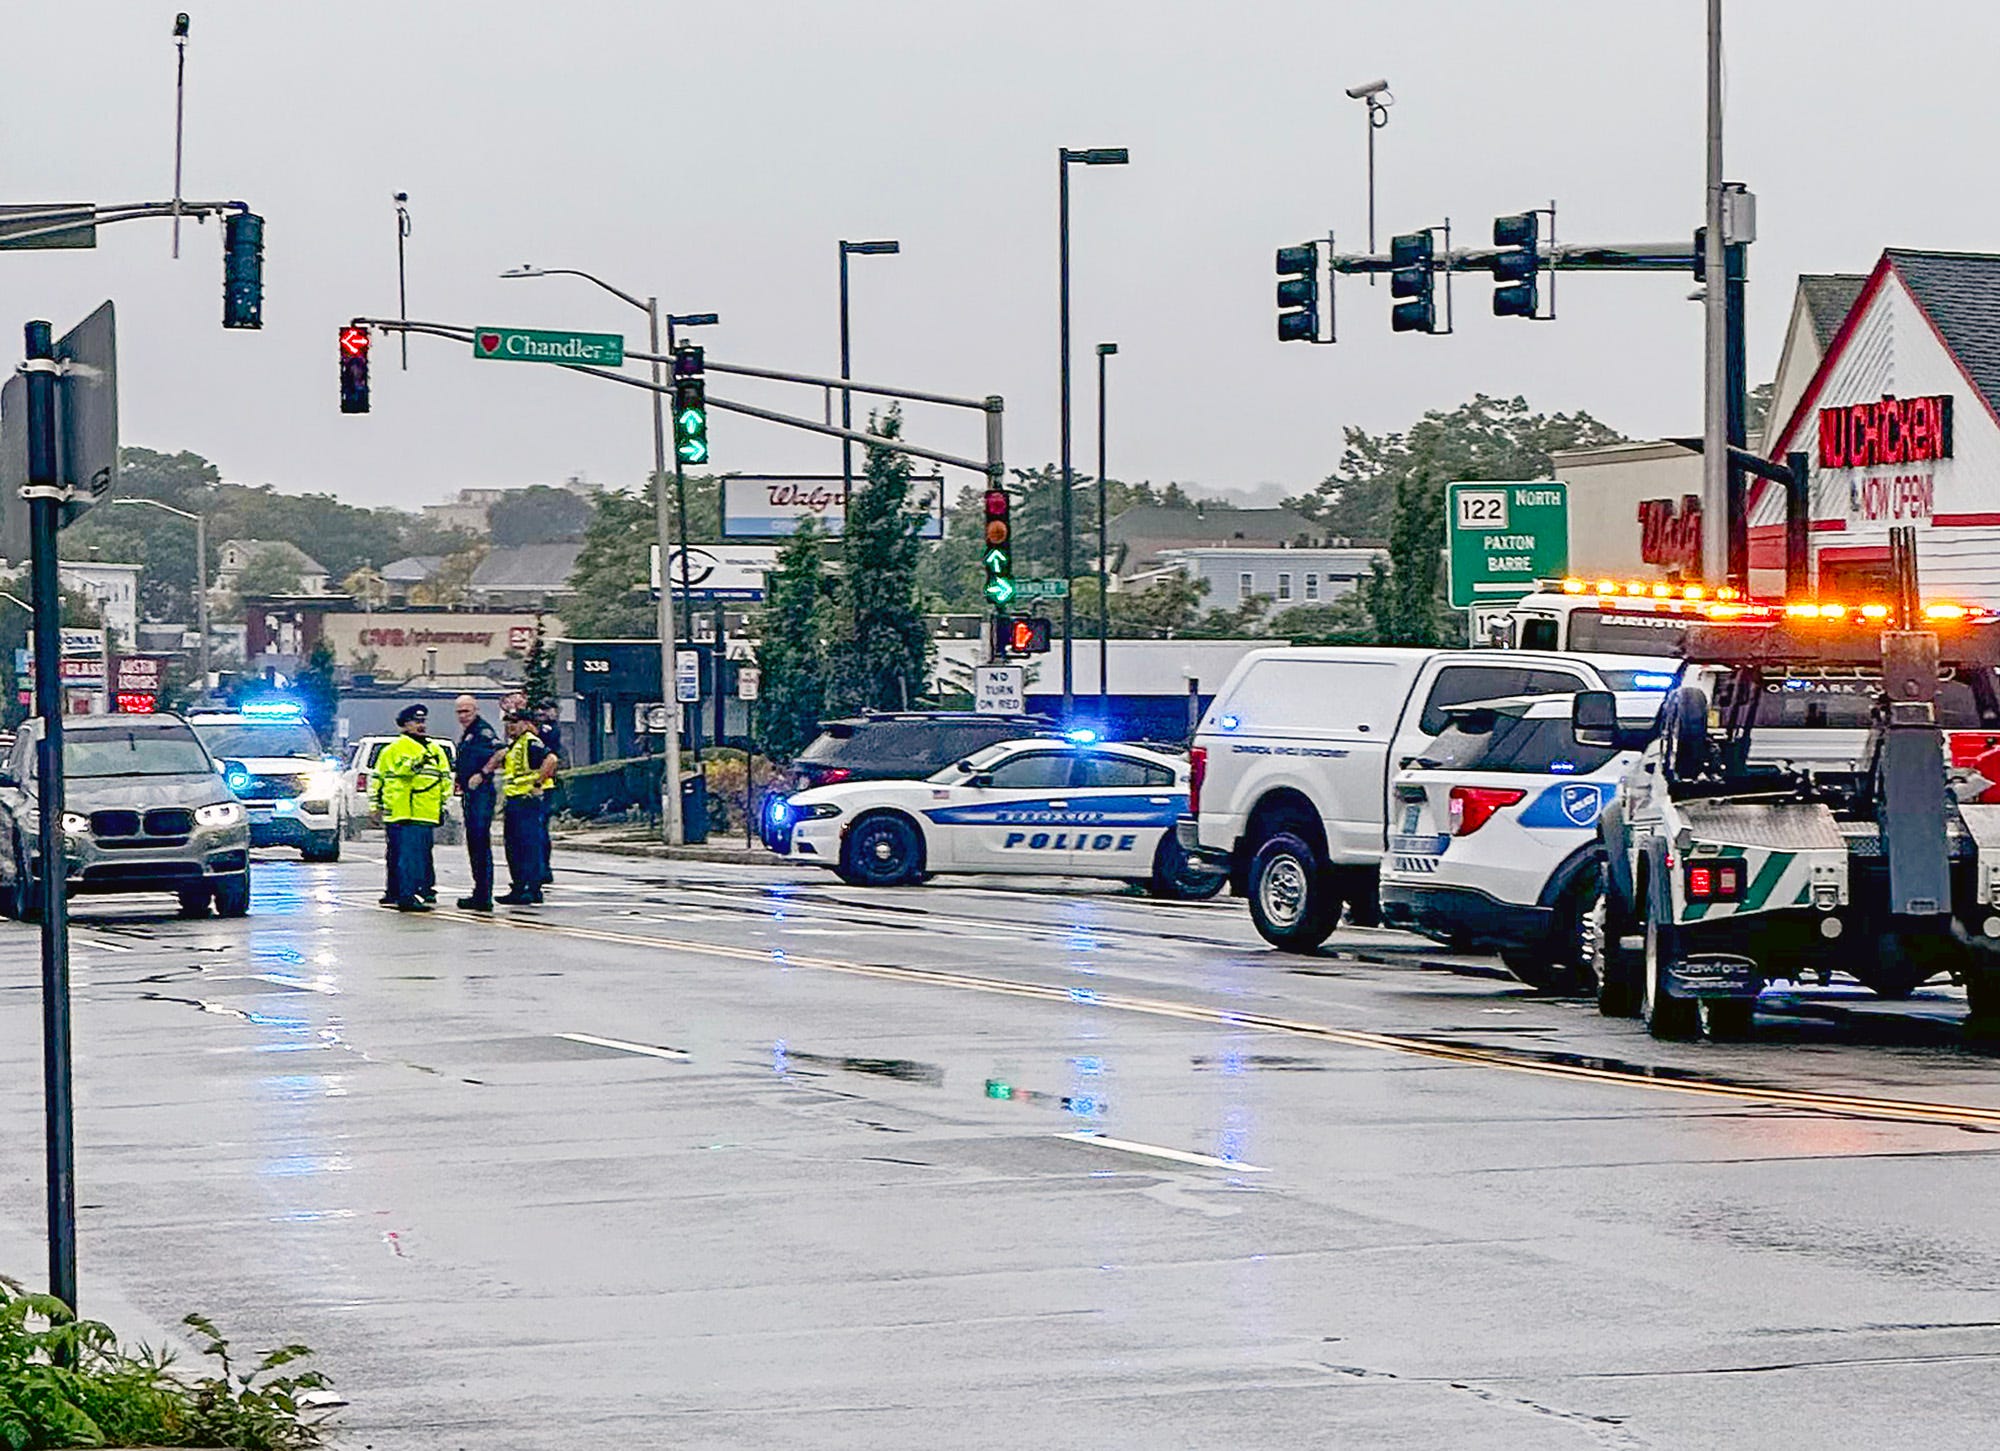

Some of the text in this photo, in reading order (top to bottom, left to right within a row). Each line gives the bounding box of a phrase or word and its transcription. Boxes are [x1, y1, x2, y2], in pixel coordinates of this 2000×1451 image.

[506, 334, 604, 359] Chandler
[766, 484, 846, 513] Walgr
[1463, 489, 1561, 519] 122 NORTH
[1484, 535, 1534, 550] PAXTON
[1487, 557, 1533, 571] BARRE
[584, 660, 610, 672] 338
[990, 672, 1009, 681] NO
[985, 685, 1014, 695] TURN
[979, 699, 1020, 710] ON RED
[1004, 832, 1137, 851] POLICE
